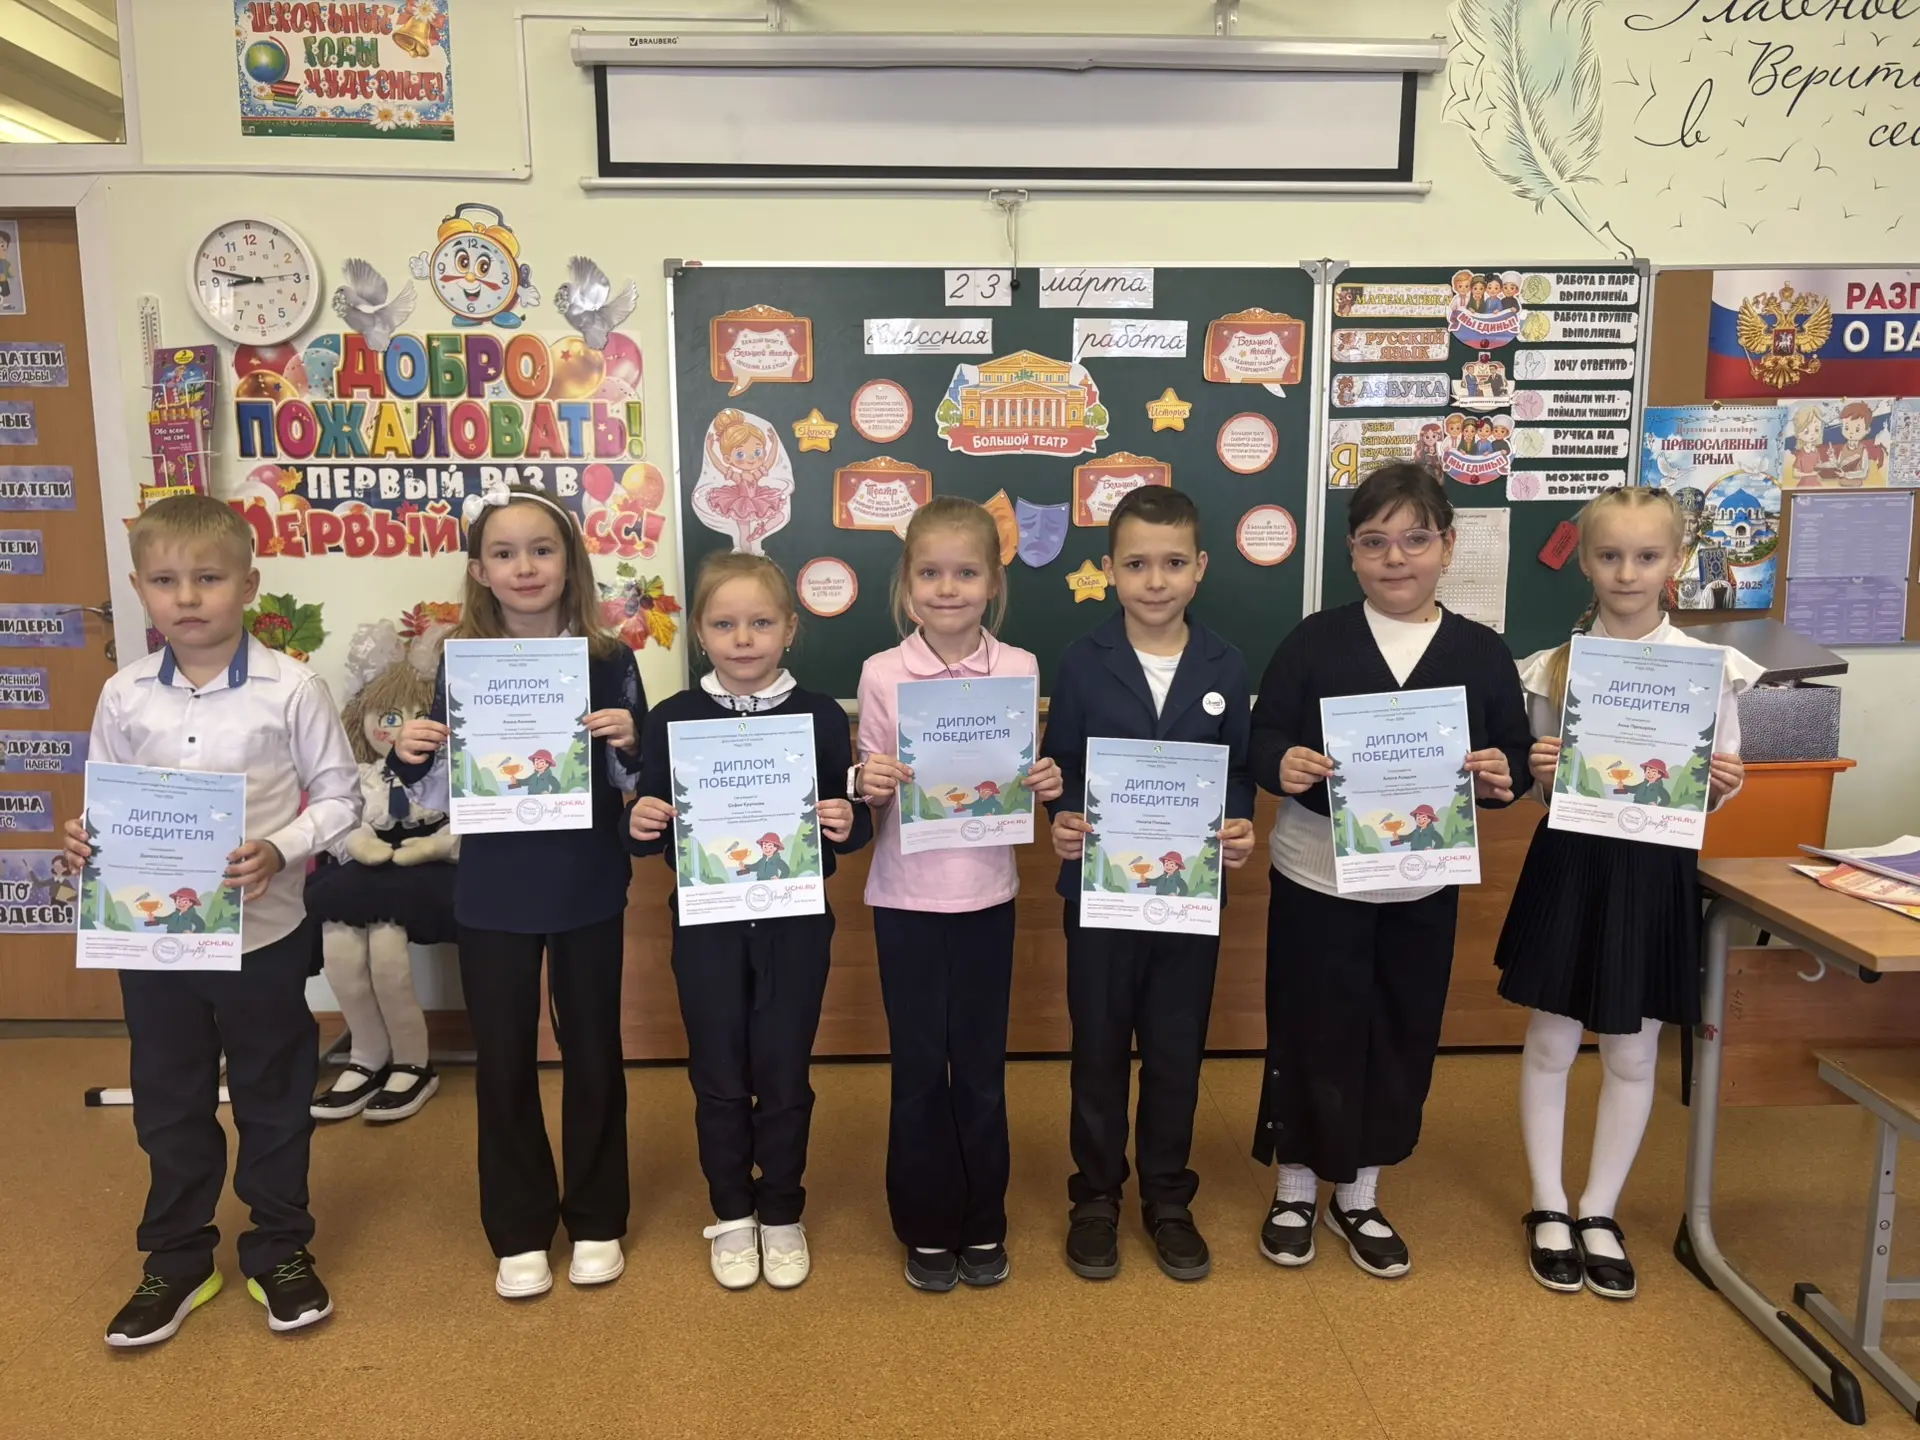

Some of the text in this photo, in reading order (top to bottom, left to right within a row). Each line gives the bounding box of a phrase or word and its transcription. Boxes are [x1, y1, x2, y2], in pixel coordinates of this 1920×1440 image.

[249, 1, 396, 36] ШКОЛЬНЫЕ
[639, 37, 678, 45] BRAUBERG
[302, 36, 380, 68] ГОДЫ
[304, 68, 445, 103] ЧУДЕСНЫЕ!
[243, 234, 257, 246] 12
[467, 238, 479, 249] 12
[225, 242, 237, 253] 11
[212, 256, 226, 267] 10
[284, 253, 292, 263] 2
[437, 262, 445, 274] 9
[212, 277, 220, 288] 9
[293, 272, 301, 284] 3
[501, 272, 510, 285] 3
[1556, 274, 1635, 286] РАБОТА В ПАРЕ
[950, 274, 1002, 299] 2 3
[290, 293, 298, 304] 4
[1355, 293, 1451, 305] МАТЕМАТИКА
[1559, 290, 1628, 302] ВЫПОЛНЕНА
[237, 309, 244, 320] 7
[278, 307, 286, 318] 5
[467, 303, 475, 313] 6
[257, 313, 266, 325] 6
[1458, 313, 1476, 329] МЫ
[1554, 312, 1632, 323] РАБОТА В ГРУППЕ
[1365, 328, 1445, 345] РУССКИЙ
[1562, 327, 1621, 339] ВЫПОЛНЕНА
[1843, 320, 1870, 352] О
[1380, 346, 1430, 360] ЯЗЫК
[338, 332, 552, 399] ДОБРО
[1554, 359, 1628, 371] ХОЧУ ОТВЕТИТЬ
[11, 370, 49, 383] СУДЬБЫ
[1358, 381, 1446, 398] АЗБУКА
[1553, 392, 1593, 403] ПОЙМАЛИ
[1548, 406, 1627, 418] ПОЙМАЛИ ТИШИНУ!
[236, 401, 644, 459] ПОЖАЛОВАТЬ!
[1361, 422, 1395, 435] узнал
[1554, 429, 1614, 440] РУЧКА НА
[973, 434, 1068, 449] БОЛЬШОЙ ТЕАТР
[1661, 436, 1768, 451] ПРАВОСЛАВНЫЙ
[1552, 445, 1619, 455] ВНИМАНИЕ
[1331, 442, 1359, 486] Я
[1448, 457, 1466, 471] МЫ
[1693, 453, 1734, 465] КРЫМ
[306, 465, 465, 499] ПЕРВЫЙ
[556, 467, 579, 497] В
[1546, 473, 1609, 482] МОЖНО
[228, 500, 462, 558] ПЕРВЫЙ
[1738, 581, 1763, 590] 2025
[488, 678, 549, 692] ДИПЛОМ
[1609, 680, 1676, 697] ДИПЛОМ
[473, 693, 564, 707] ПОБЕДИТЕЛЯ
[1592, 694, 1690, 714] ПОБЕДИТЕЛЯ
[936, 715, 996, 729] ДИПЛОМ
[922, 728, 1010, 743] ПОБЕДИТЕЛЯ
[1366, 732, 1428, 748] ДИПЛОМ
[7, 740, 72, 756] ДРУЗЬЯ
[1352, 746, 1444, 763] ПОБЕДИТЕЛЯ
[713, 758, 775, 774] ДИПЛОМ
[699, 773, 791, 789] ПОБЕДИТЕЛЯ
[1125, 778, 1185, 792] ДИПЛОМ
[1110, 793, 1199, 807] ПОБЕДИТЕЛЯ
[128, 808, 198, 825] ДИПЛОМ
[112, 823, 214, 841] ПОБЕДИТЕЛЯ
